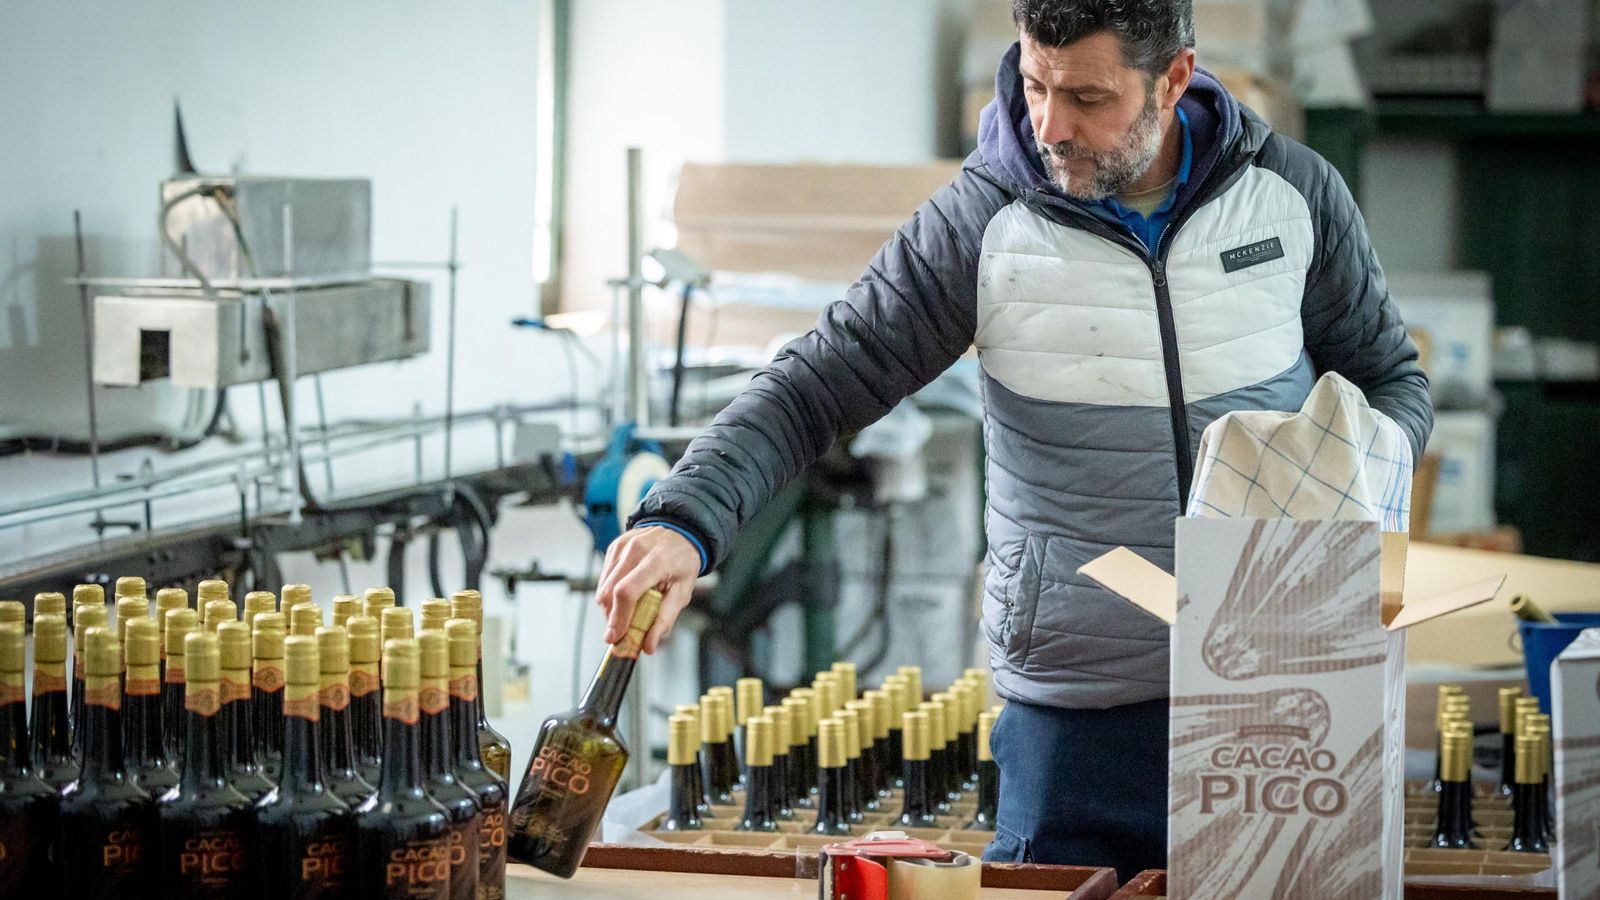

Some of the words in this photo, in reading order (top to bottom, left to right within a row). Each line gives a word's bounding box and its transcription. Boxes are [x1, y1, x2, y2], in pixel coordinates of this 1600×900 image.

[1229, 242, 1275, 260] MCKENZIE
[540, 746, 591, 774] CACAO
[1211, 747, 1337, 772] CACAO
[530, 757, 589, 794] PICO
[1199, 774, 1349, 818] PICO
[386, 861, 450, 885] PICO
